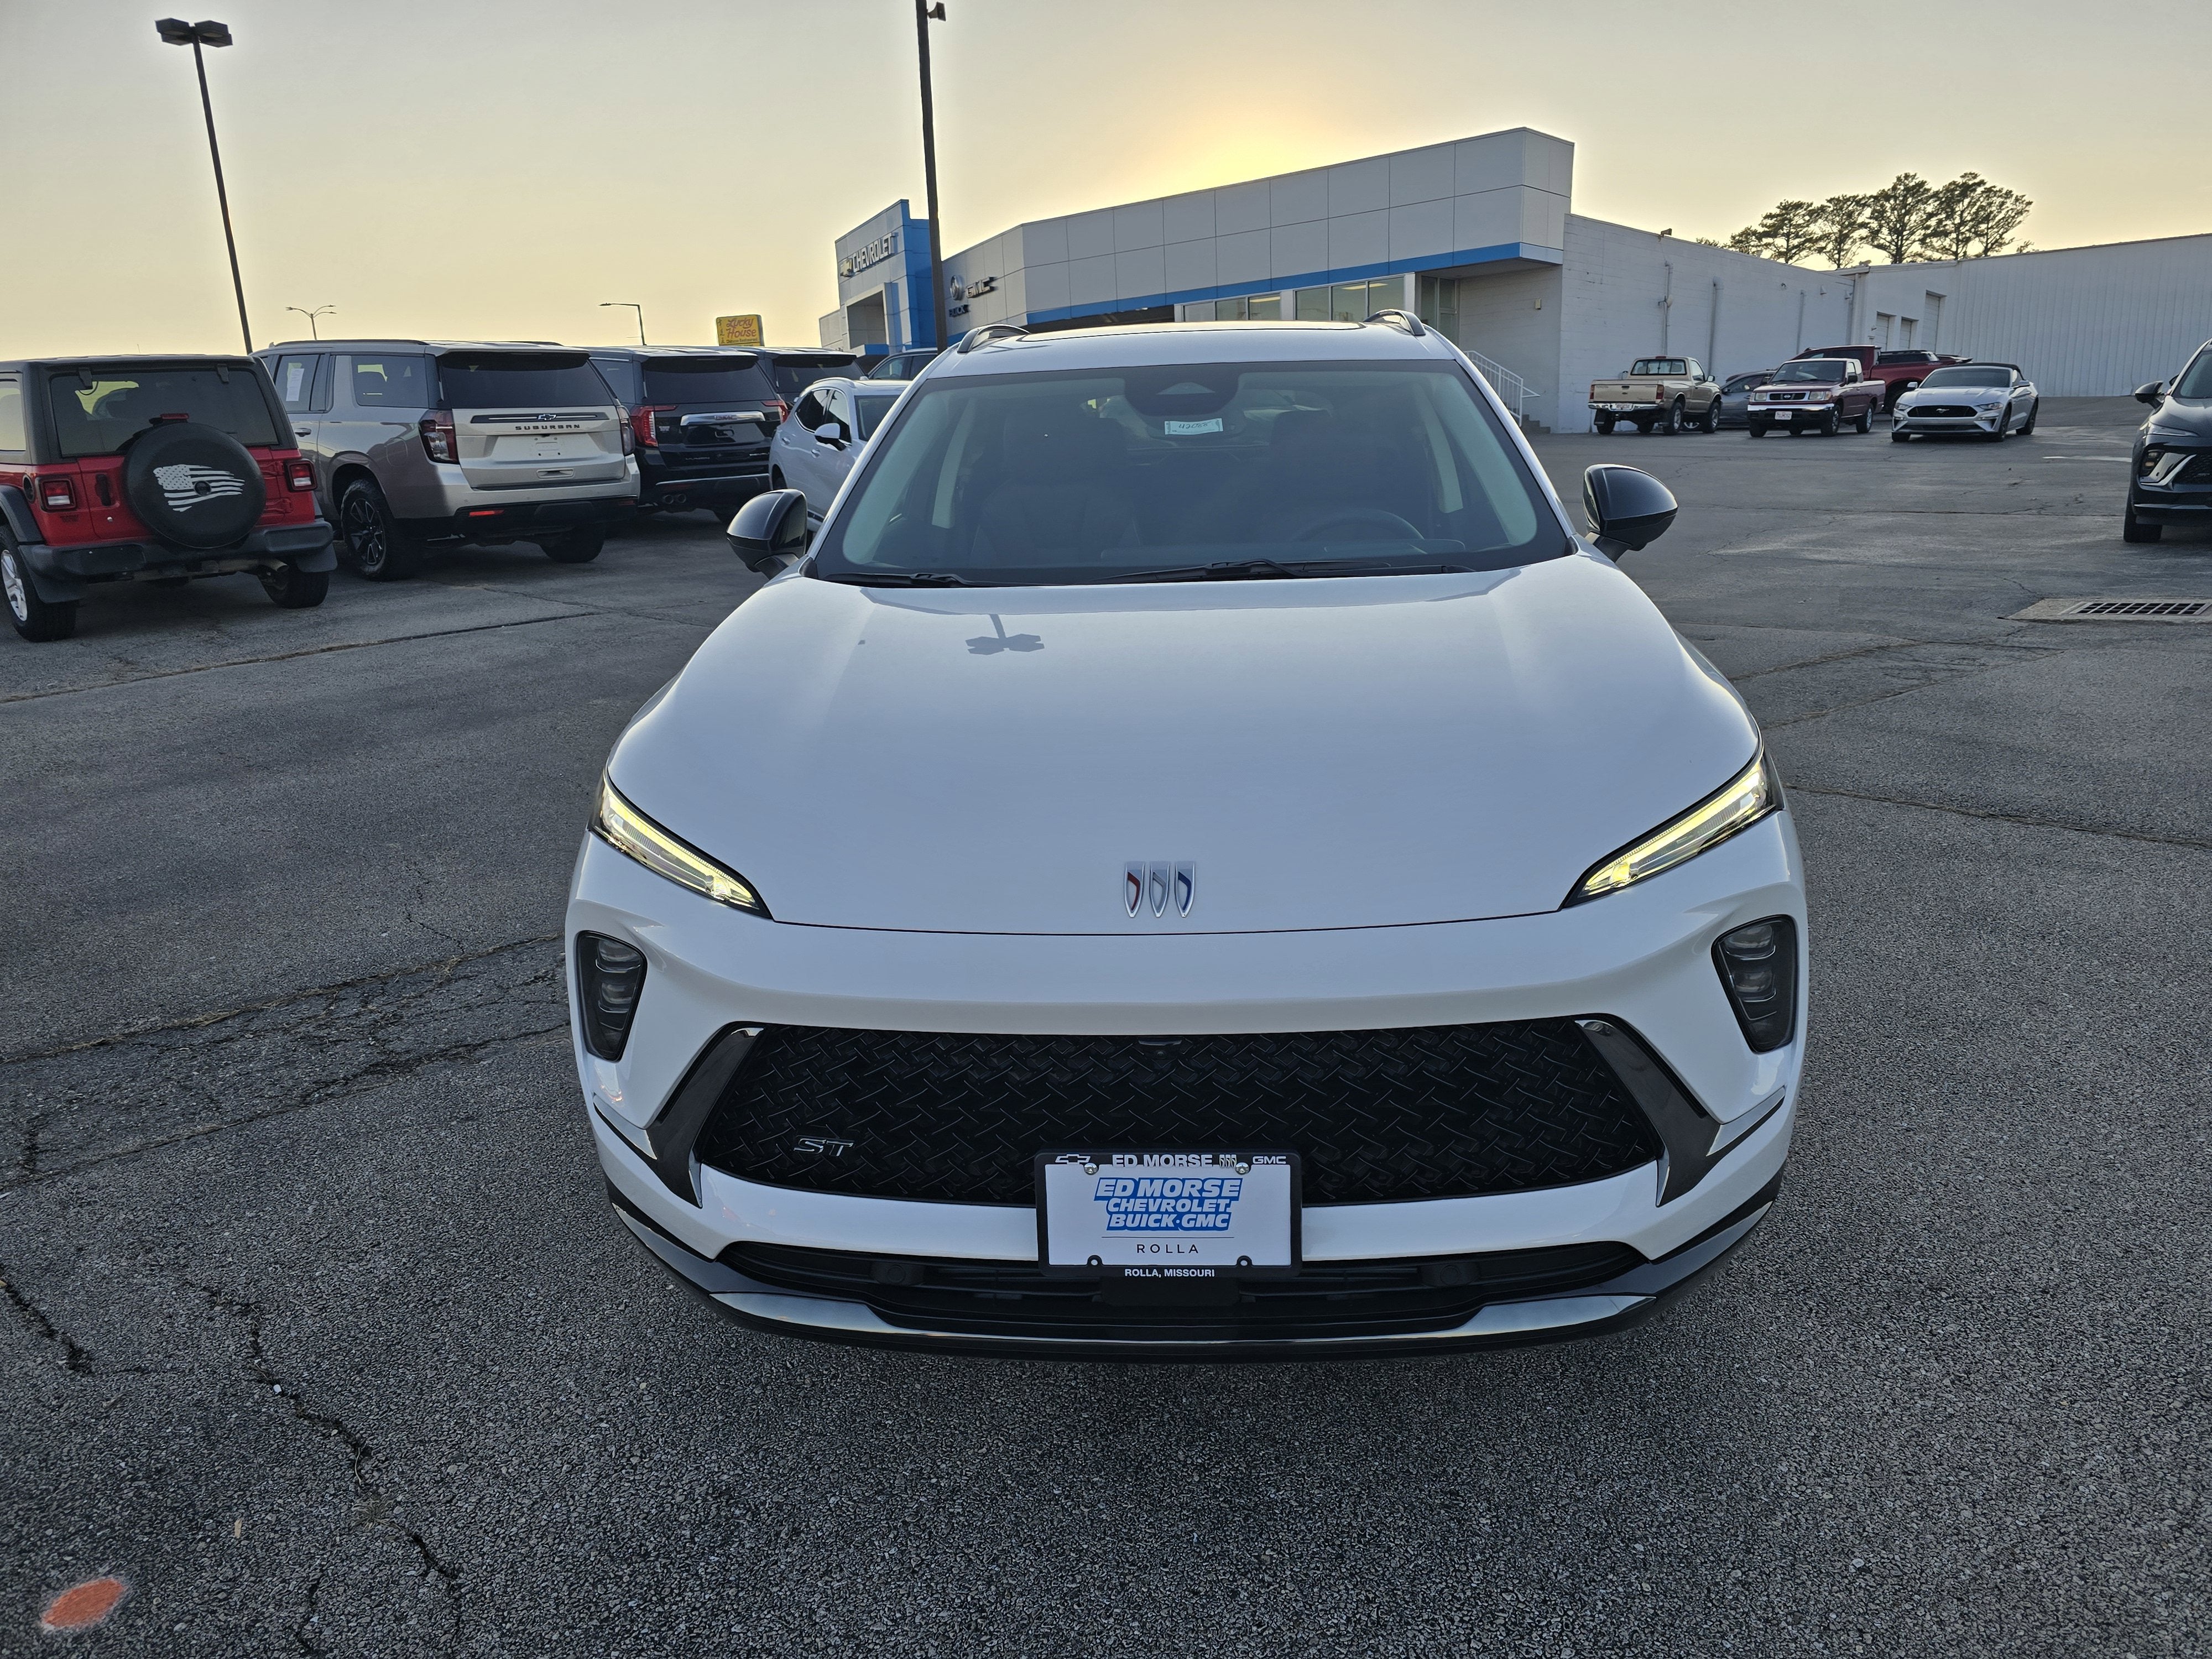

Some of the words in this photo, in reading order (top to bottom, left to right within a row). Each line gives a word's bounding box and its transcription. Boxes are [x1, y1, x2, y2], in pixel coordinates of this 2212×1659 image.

[852, 232, 892, 273] CHEVROLET
[966, 276, 990, 299] GMC
[726, 317, 754, 329] Lucky
[726, 328, 757, 338] House
[793, 1138, 854, 1156] ST
[1112, 1154, 1138, 1167] ED
[1143, 1154, 1213, 1167] MORSE
[1253, 1156, 1286, 1164] GMC
[1096, 1179, 1135, 1197] ED
[1137, 1179, 1241, 1197] MORSE
[1108, 1198, 1230, 1212] CHEVROLET
[1136, 1244, 1198, 1254] ROLLA
[1124, 1269, 1161, 1277] ROLLA,
[1164, 1269, 1215, 1277] MISSOURI
